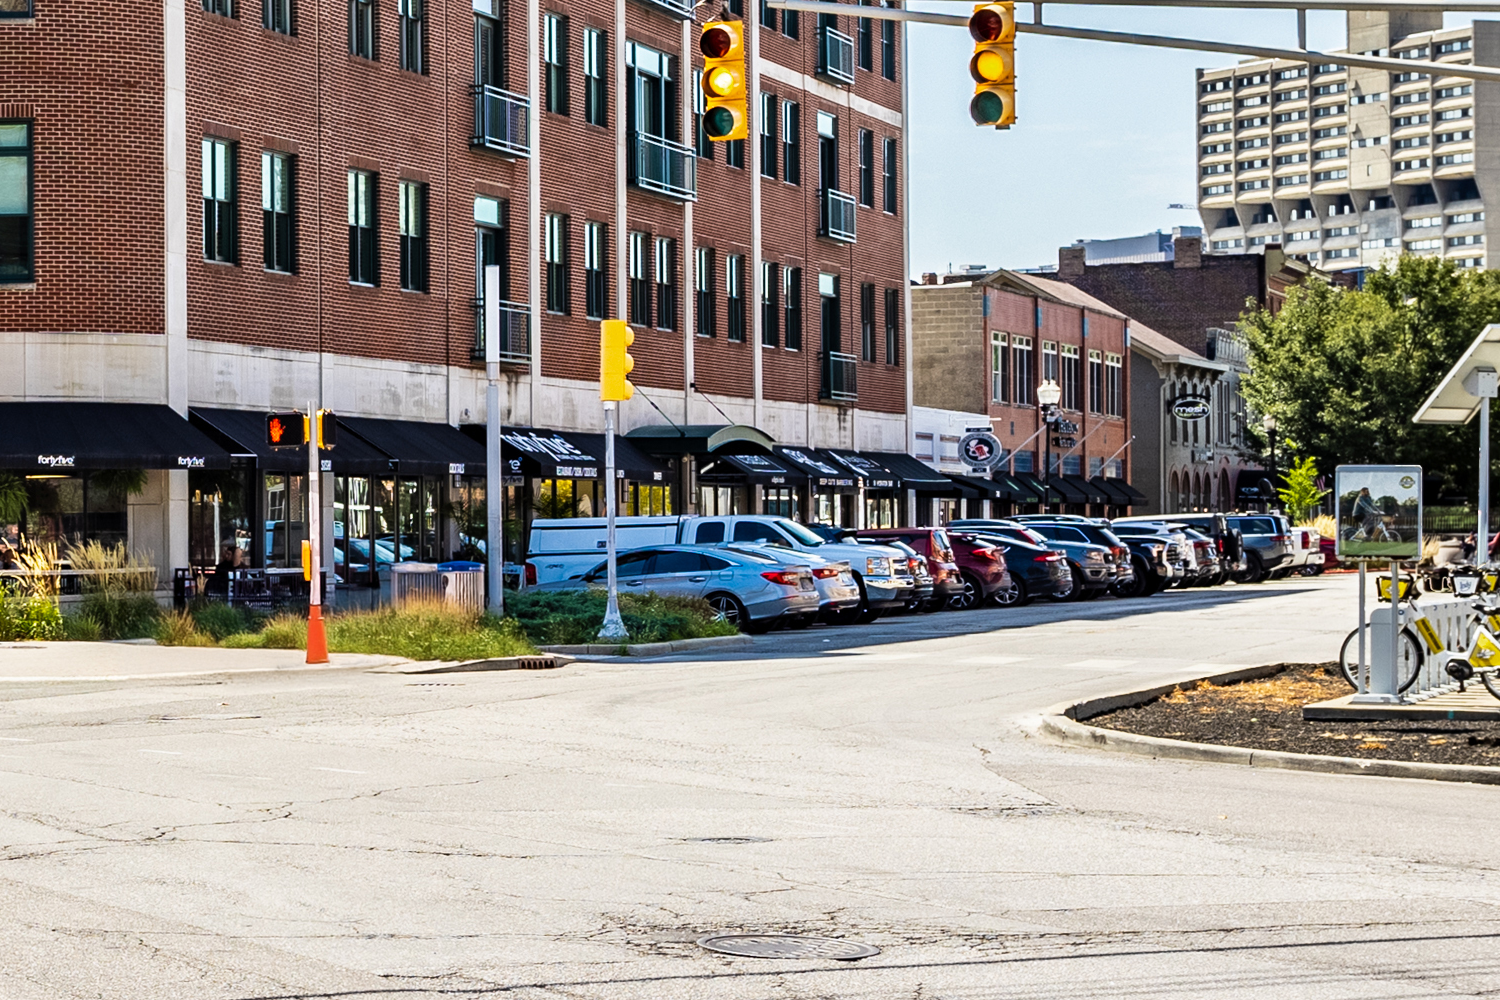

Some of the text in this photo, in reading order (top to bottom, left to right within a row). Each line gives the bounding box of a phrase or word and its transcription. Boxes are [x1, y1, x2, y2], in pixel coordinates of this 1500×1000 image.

[1175, 403, 1208, 413] mesh
[37, 455, 75, 467] fortyfive
[177, 456, 205, 468] fortyfive
